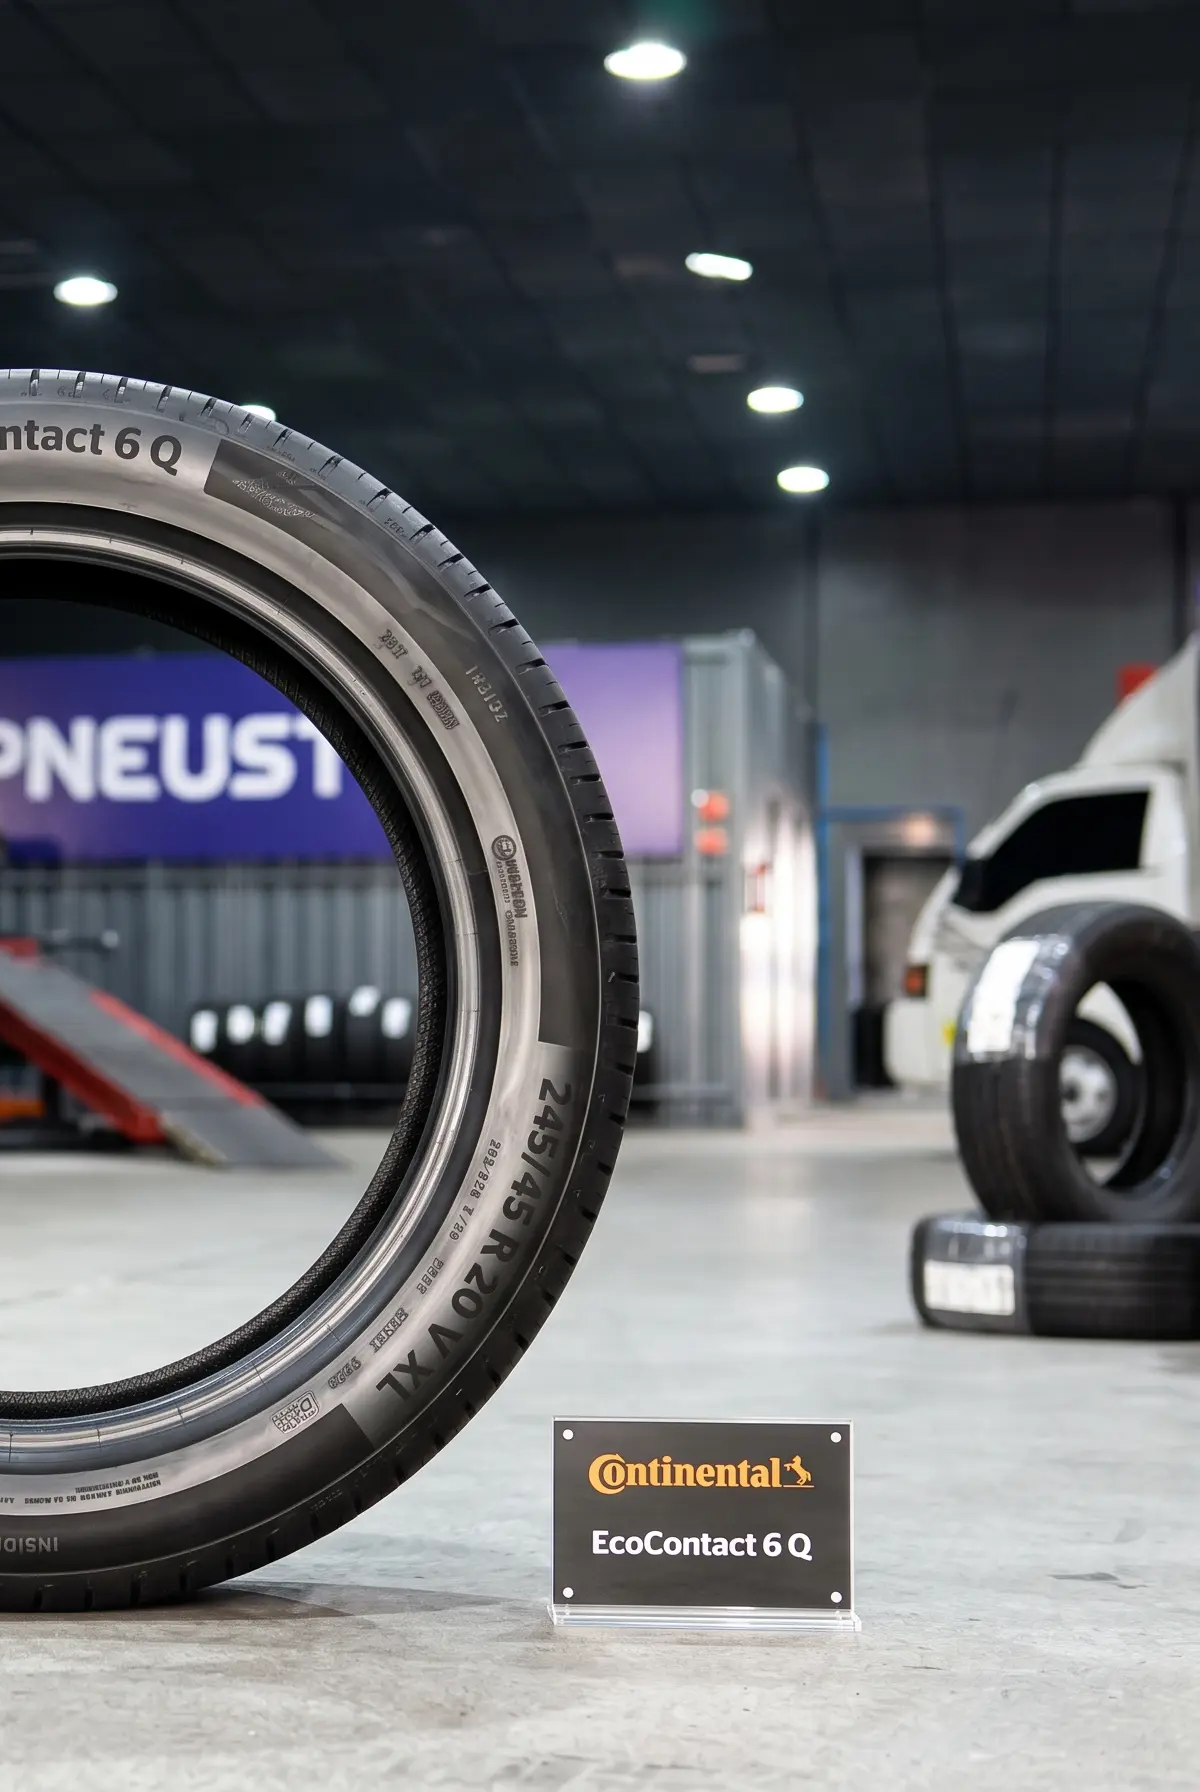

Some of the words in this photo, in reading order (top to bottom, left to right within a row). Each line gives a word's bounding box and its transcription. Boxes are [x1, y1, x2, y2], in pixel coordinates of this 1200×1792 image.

[114, 426, 142, 460] 6
[150, 434, 183, 476] Q
[503, 1078, 571, 1227] 245/45
[480, 1228, 520, 1263] R
[451, 1263, 499, 1319] 20
[427, 1323, 464, 1360] V
[375, 1349, 435, 1401] XL
[588, 1453, 782, 1495] Continental
[592, 1530, 757, 1557] EcoContact
[763, 1532, 782, 1557] 6
[788, 1533, 812, 1561] Q
